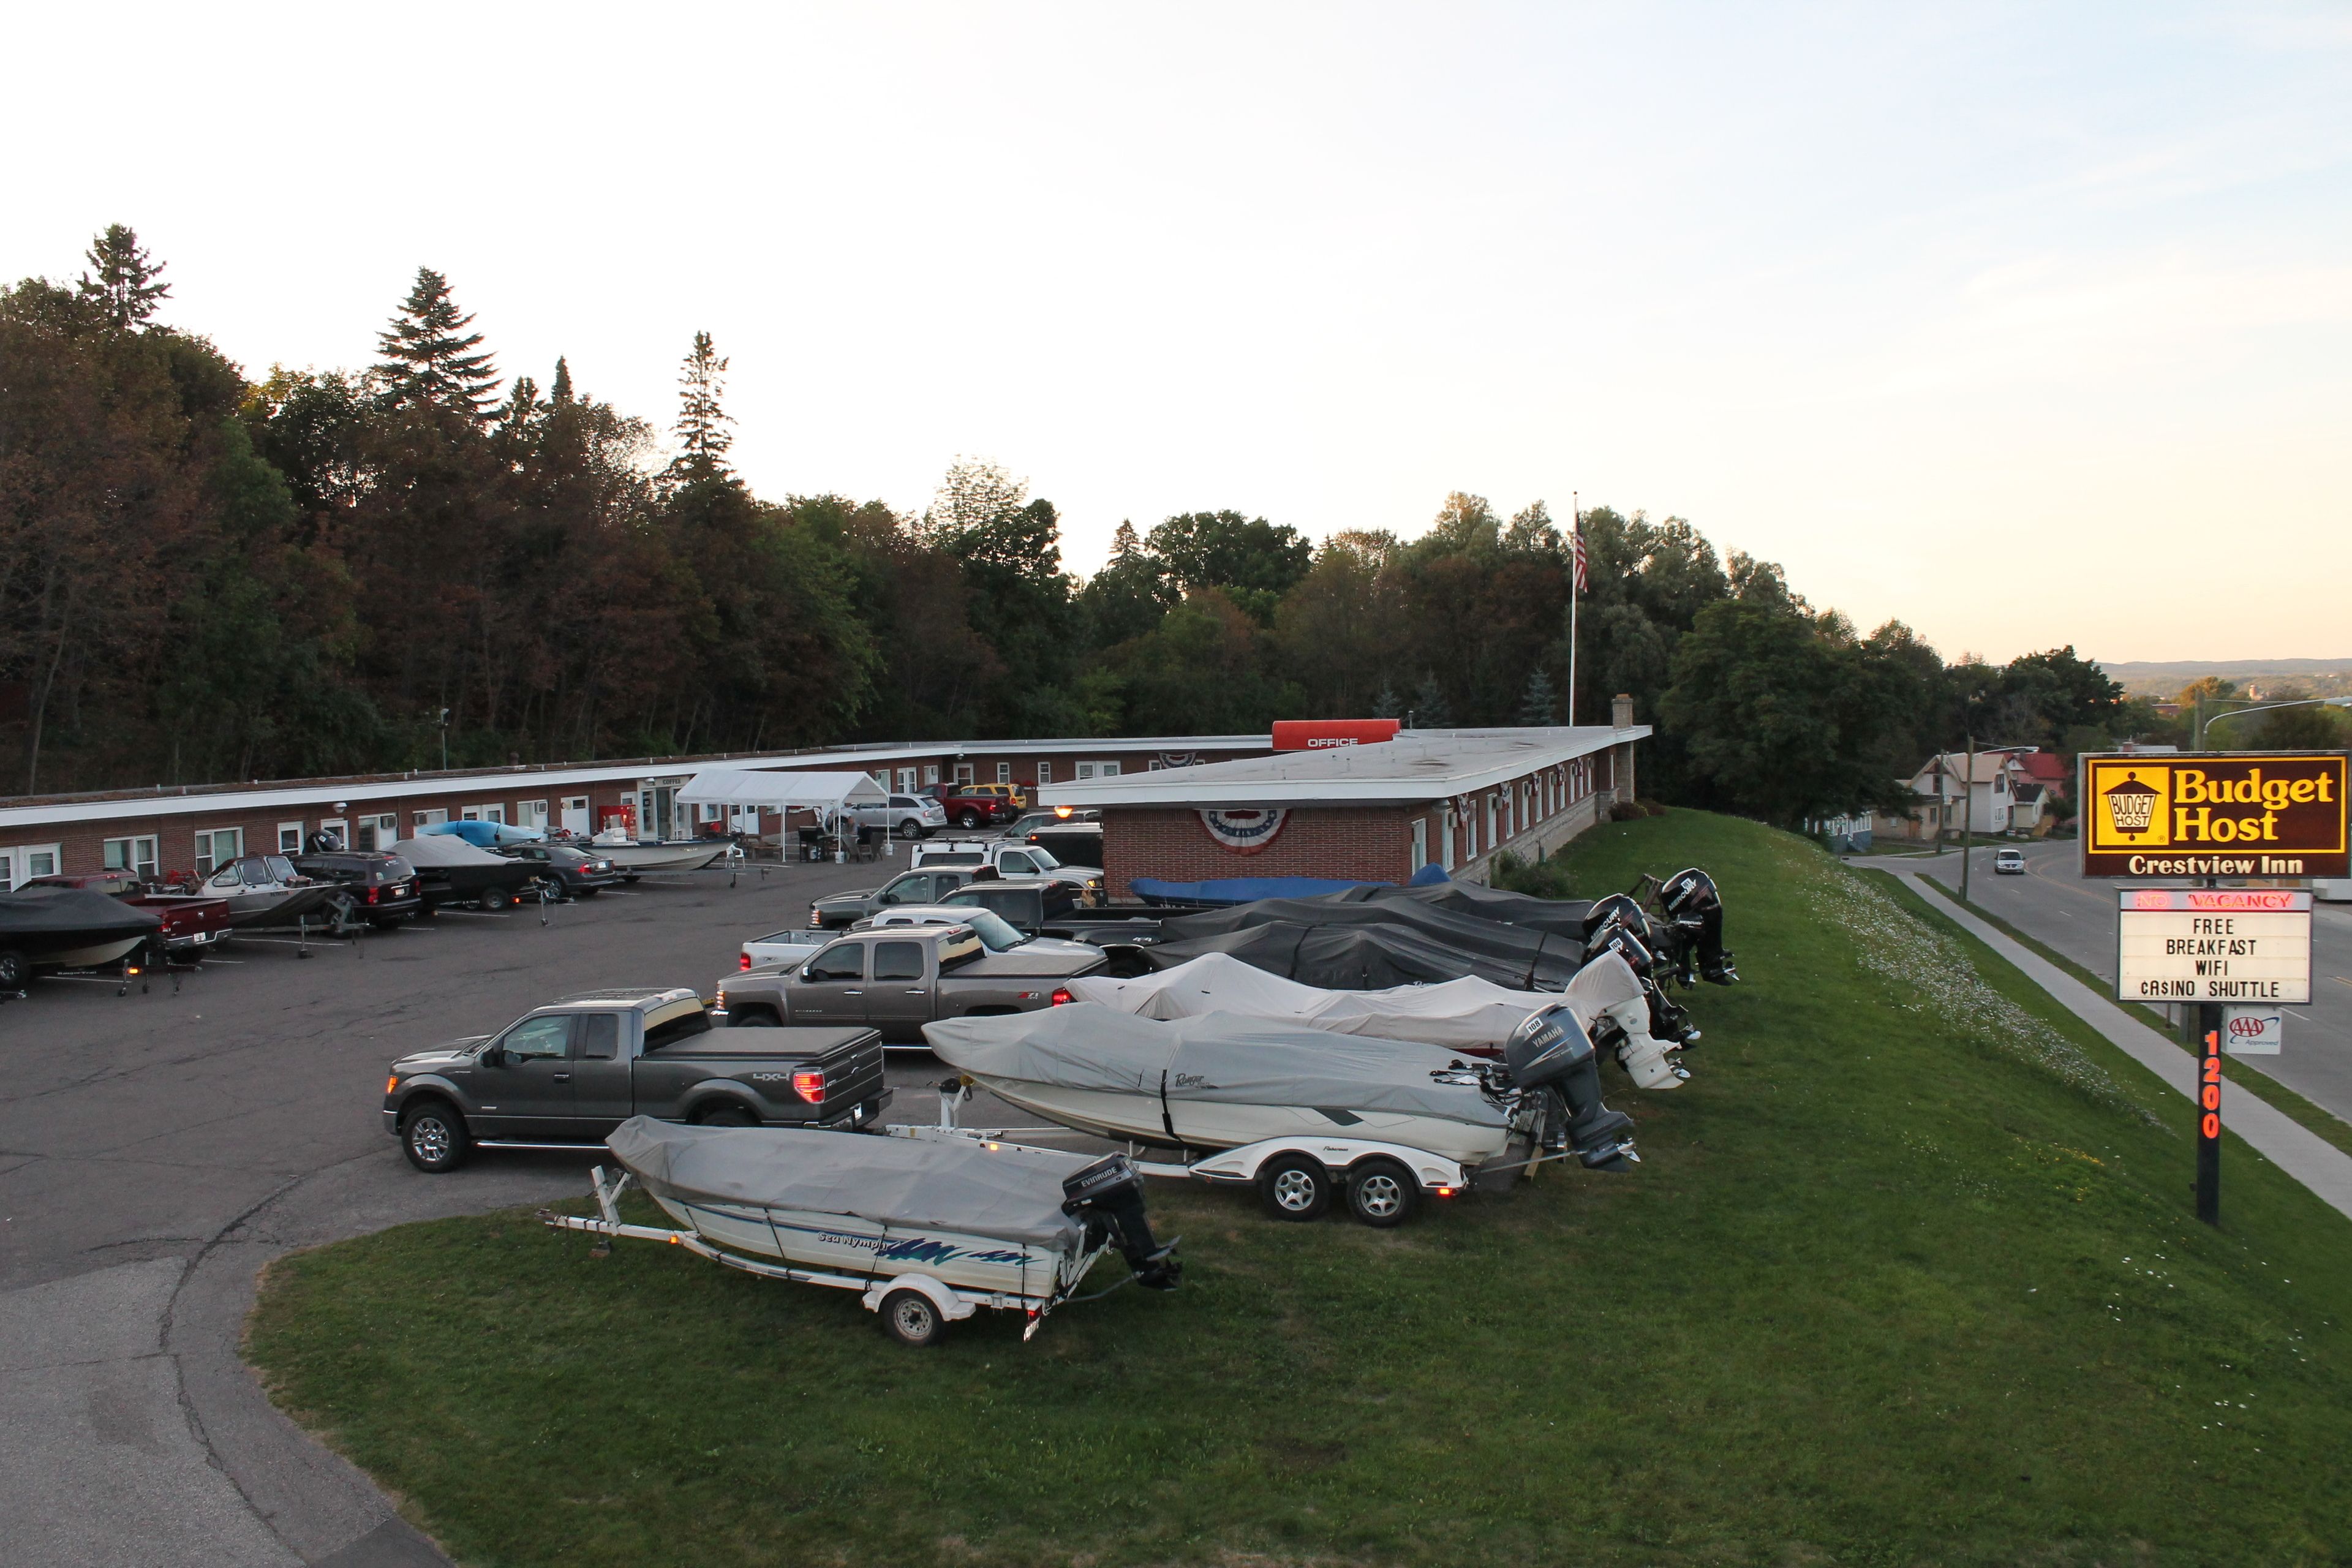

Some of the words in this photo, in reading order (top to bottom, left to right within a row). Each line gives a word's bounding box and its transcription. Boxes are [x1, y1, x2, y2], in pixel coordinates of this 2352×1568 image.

[1308, 738, 1359, 747] OFFICE
[2173, 768, 2333, 810] Budget
[2110, 795, 2154, 815] BUDGET
[2115, 815, 2149, 826] HOST
[2173, 807, 2279, 843] Host
[2128, 855, 2255, 875] Crestview
[2261, 855, 2303, 875] Inn
[2138, 894, 2169, 908] NO
[2188, 893, 2293, 908] VACANCY
[2193, 918, 2234, 935] FREE
[1610, 940, 1622, 949] 100
[2166, 939, 2257, 956] BREAKFAST
[2195, 960, 2228, 976] WIFI
[2209, 981, 2279, 998] SHUTTLE
[1528, 1020, 1541, 1033] 108
[2231, 1018, 2263, 1036] AAA
[1532, 1025, 1564, 1048] YAMAHA
[1175, 1072, 1205, 1087] Ranger
[2203, 1030, 2221, 1139] 1200
[1080, 1166, 1118, 1188] EVINRUDE
[818, 1231, 840, 1243] Sea
[843, 1235, 888, 1251] Nymph
